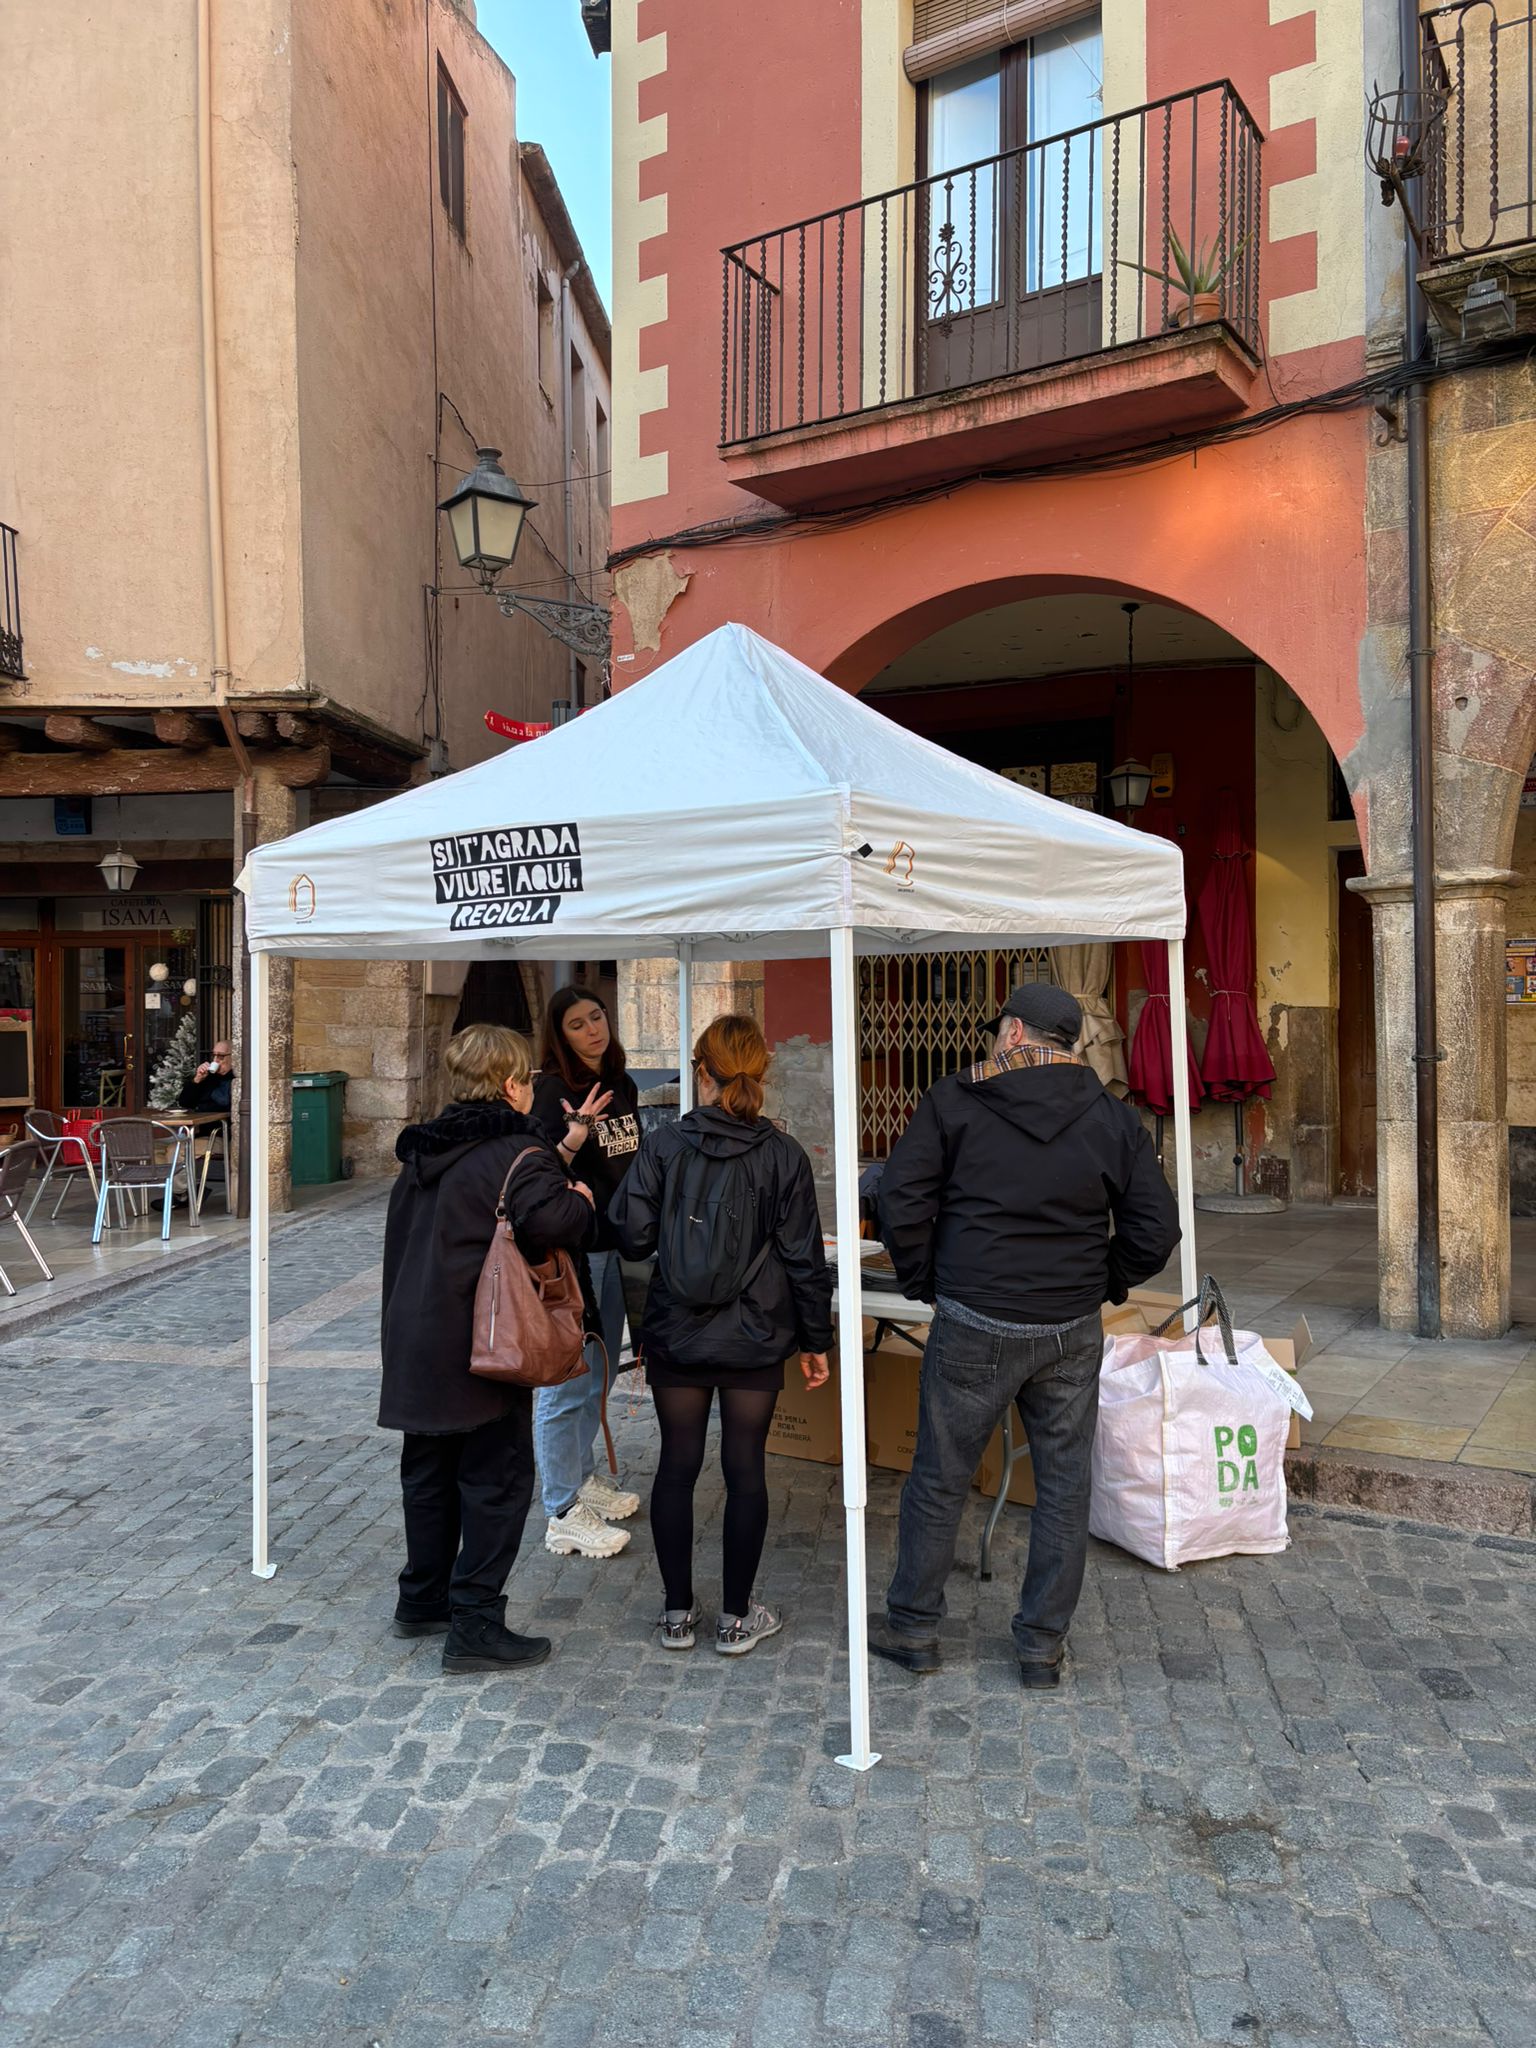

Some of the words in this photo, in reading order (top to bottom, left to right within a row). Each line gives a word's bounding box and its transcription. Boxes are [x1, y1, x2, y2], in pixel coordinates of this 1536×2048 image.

[433, 841, 455, 867] SI
[459, 826, 577, 864] T'AGRADA
[438, 867, 505, 900] VIURE
[102, 908, 172, 926] ISAMA
[455, 899, 551, 928] RECICLA
